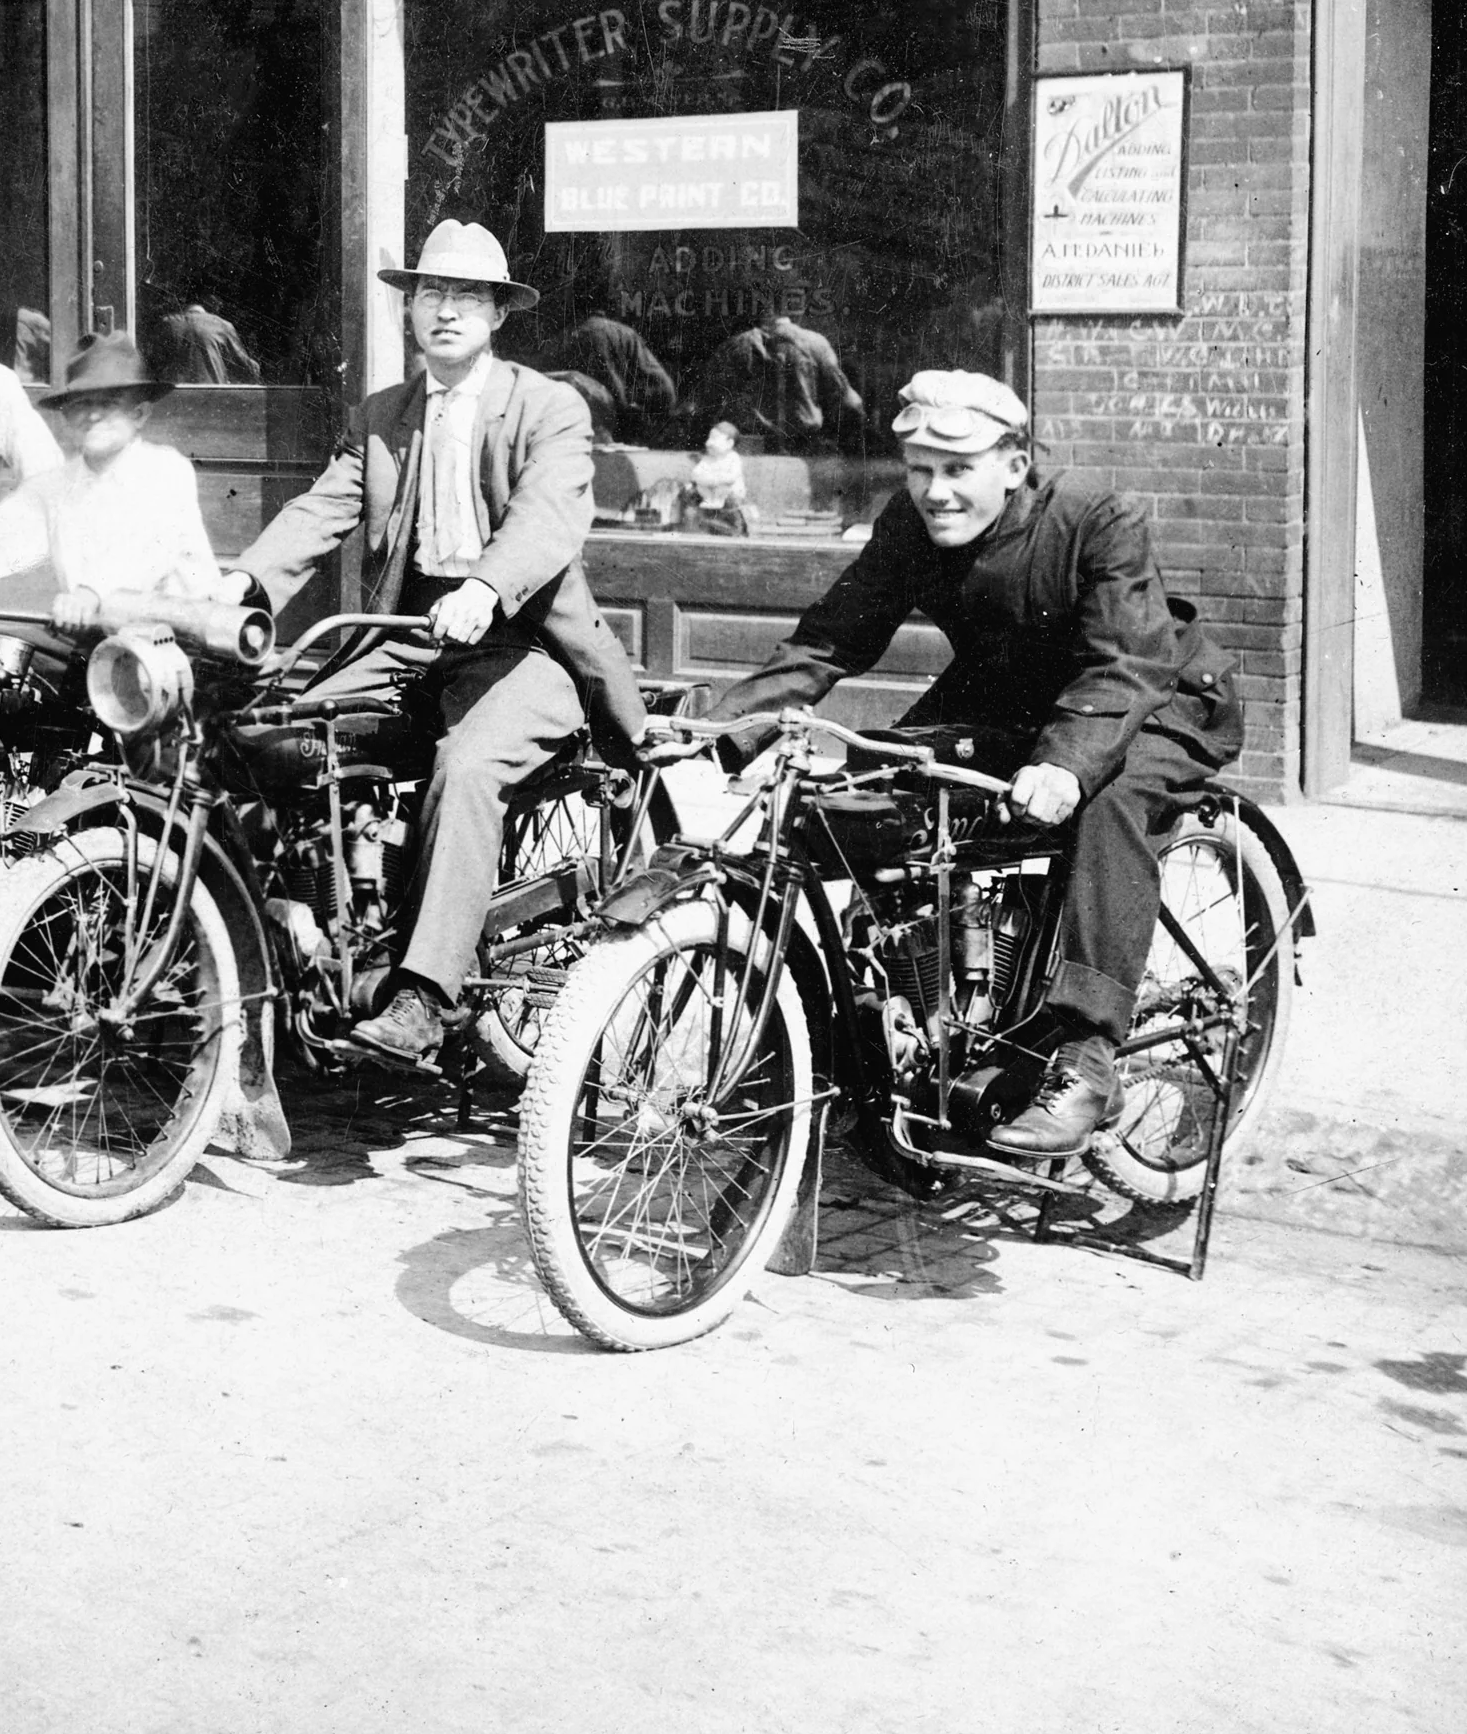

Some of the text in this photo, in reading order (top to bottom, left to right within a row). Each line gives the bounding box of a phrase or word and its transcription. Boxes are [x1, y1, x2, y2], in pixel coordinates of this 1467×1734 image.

[420, 8, 627, 166] TYPEWRITER
[657, 0, 842, 72] SUPPLY
[564, 132, 772, 166] WESTERN
[561, 184, 629, 212] BLUE
[638, 182, 720, 210] PRINT
[649, 245, 794, 274] ADDING
